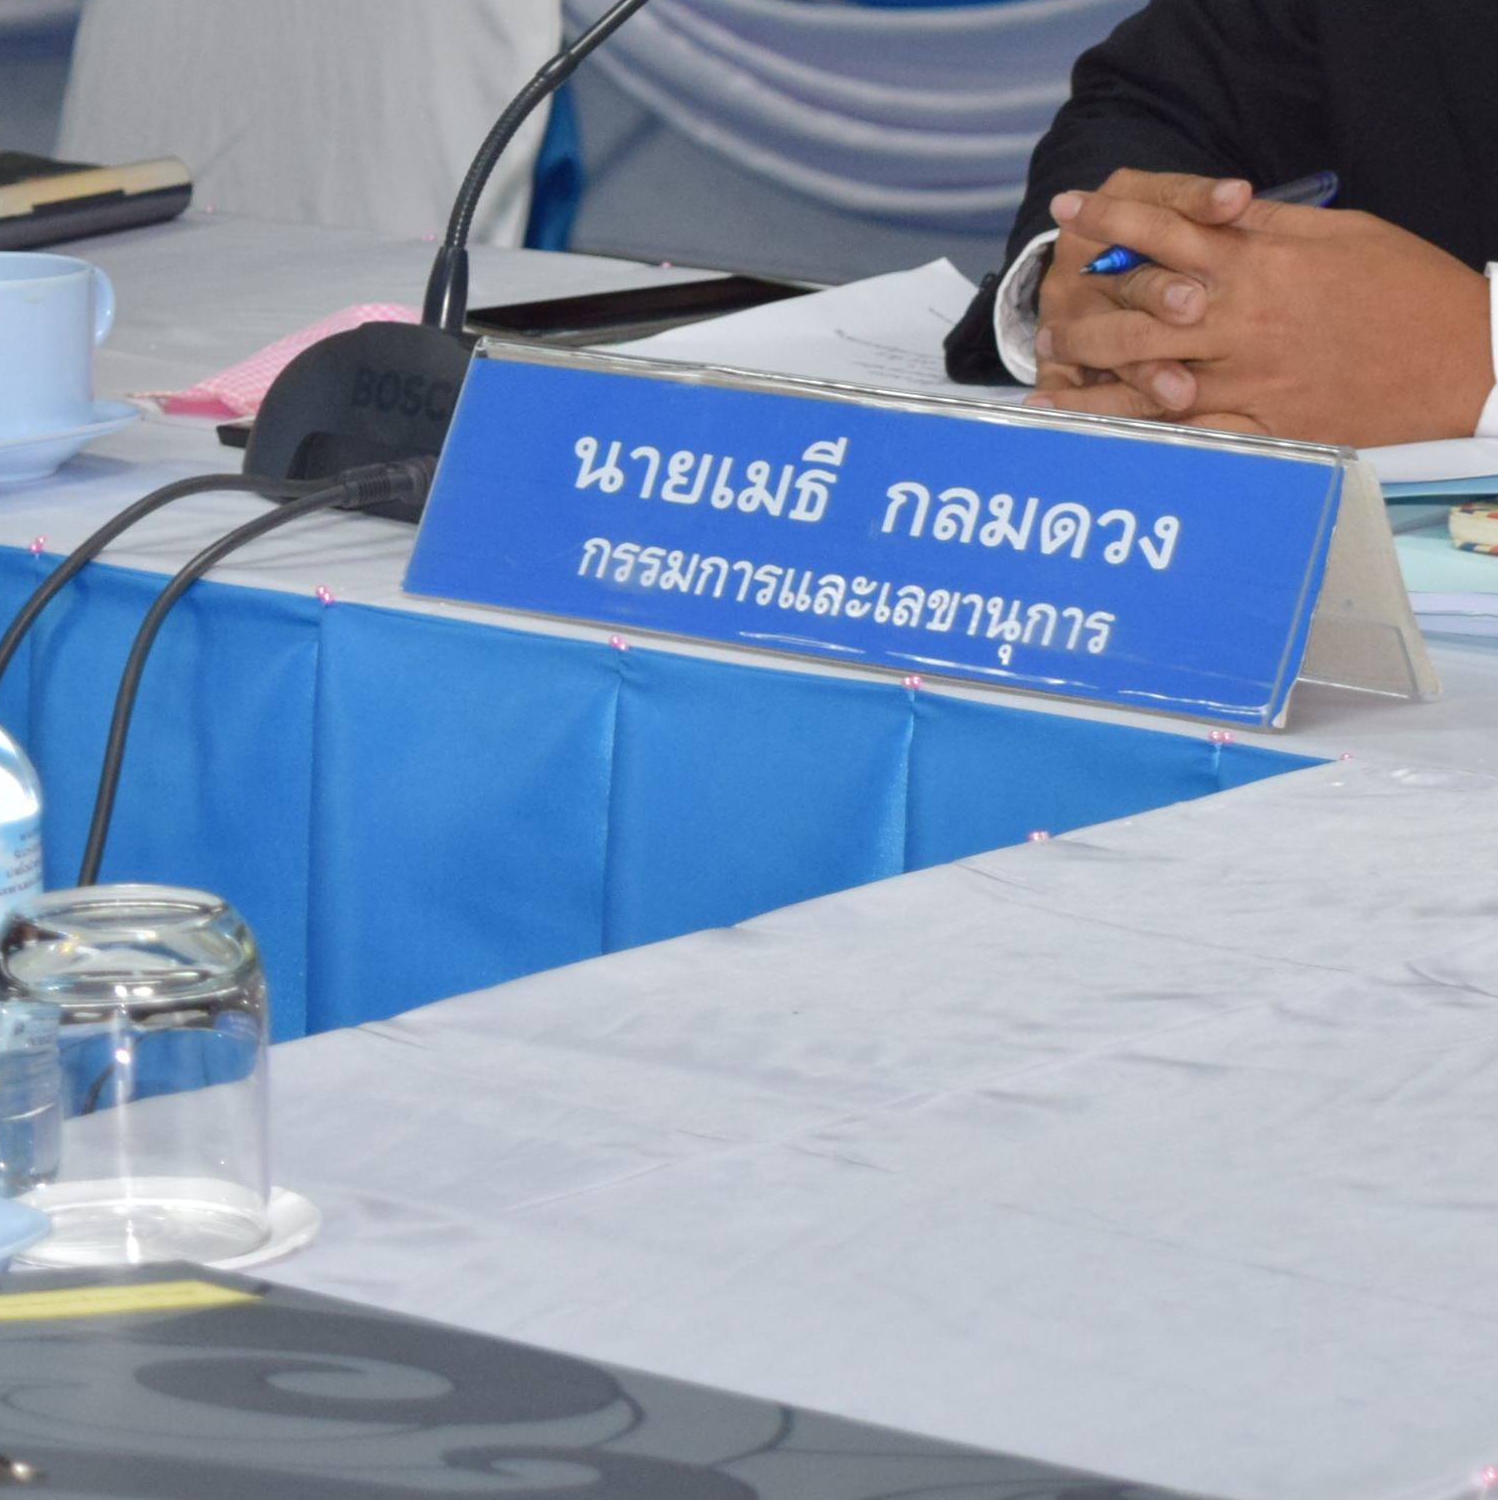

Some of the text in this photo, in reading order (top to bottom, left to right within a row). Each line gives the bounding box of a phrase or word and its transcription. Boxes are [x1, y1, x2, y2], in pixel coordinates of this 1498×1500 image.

[352, 366, 461, 422] BOSC
[573, 436, 1182, 571] นายเมธี กลมดวง
[576, 536, 1116, 666] กรรมการและเลขานุการ
